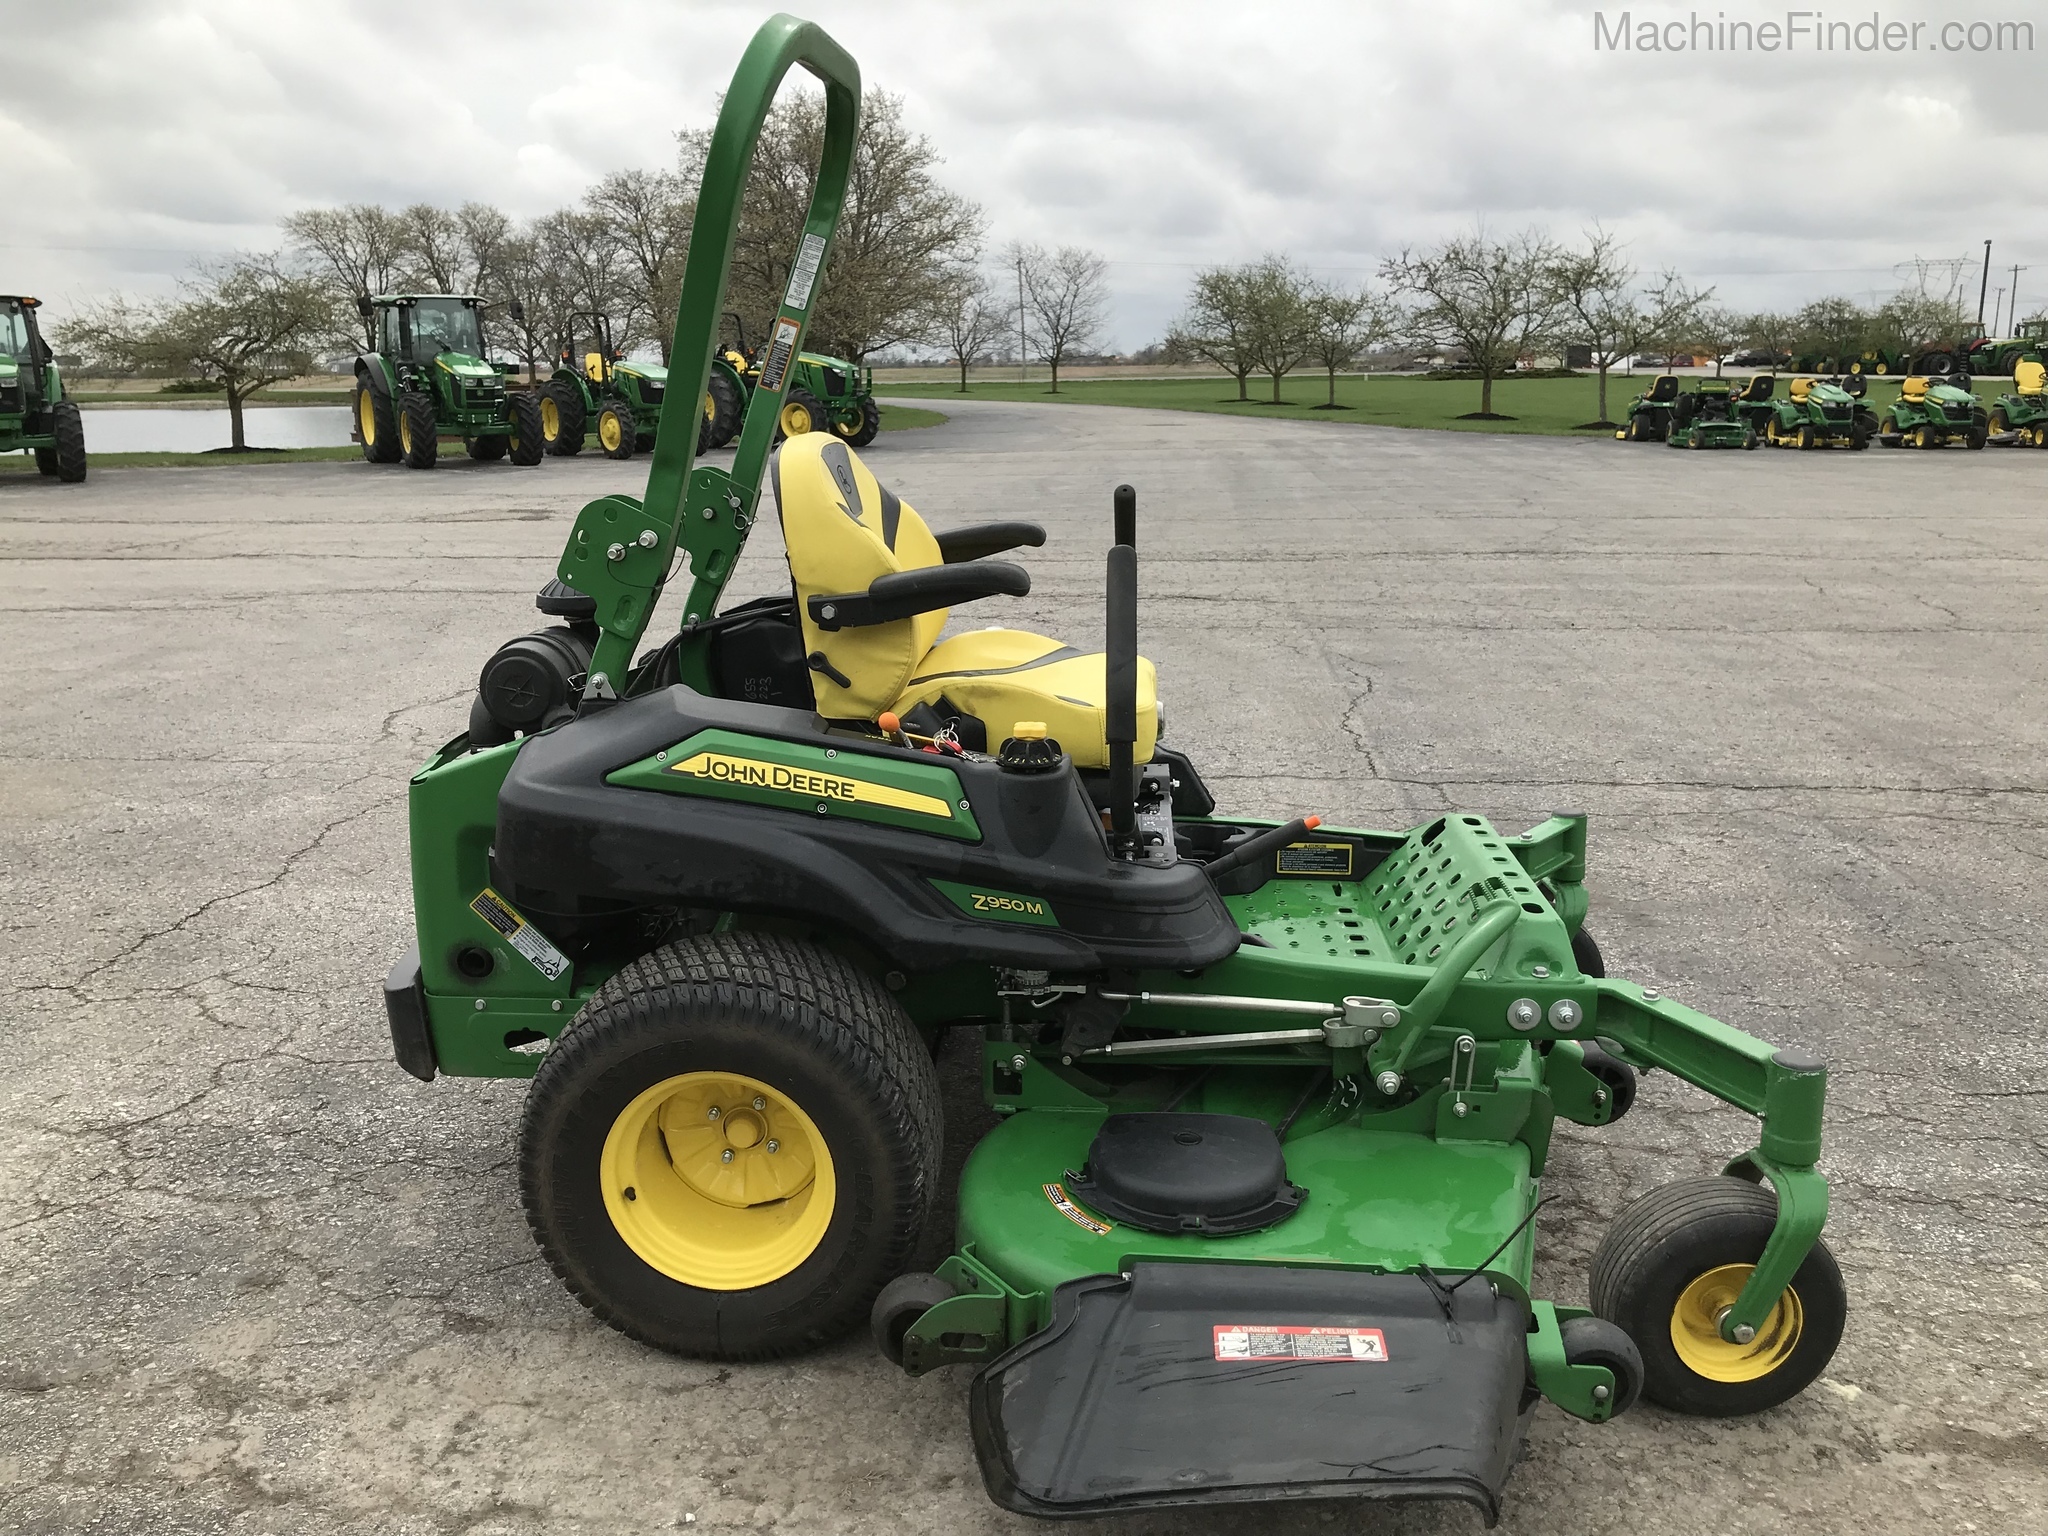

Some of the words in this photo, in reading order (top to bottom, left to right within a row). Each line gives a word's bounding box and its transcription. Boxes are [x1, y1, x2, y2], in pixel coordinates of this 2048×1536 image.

[696, 756, 766, 784] JOHN
[772, 766, 856, 799] DEERE
[496, 899, 517, 919] CAUTION
[763, 1171, 874, 1334] CARLISLE
[1320, 1327, 1359, 1335] PELIGRO
